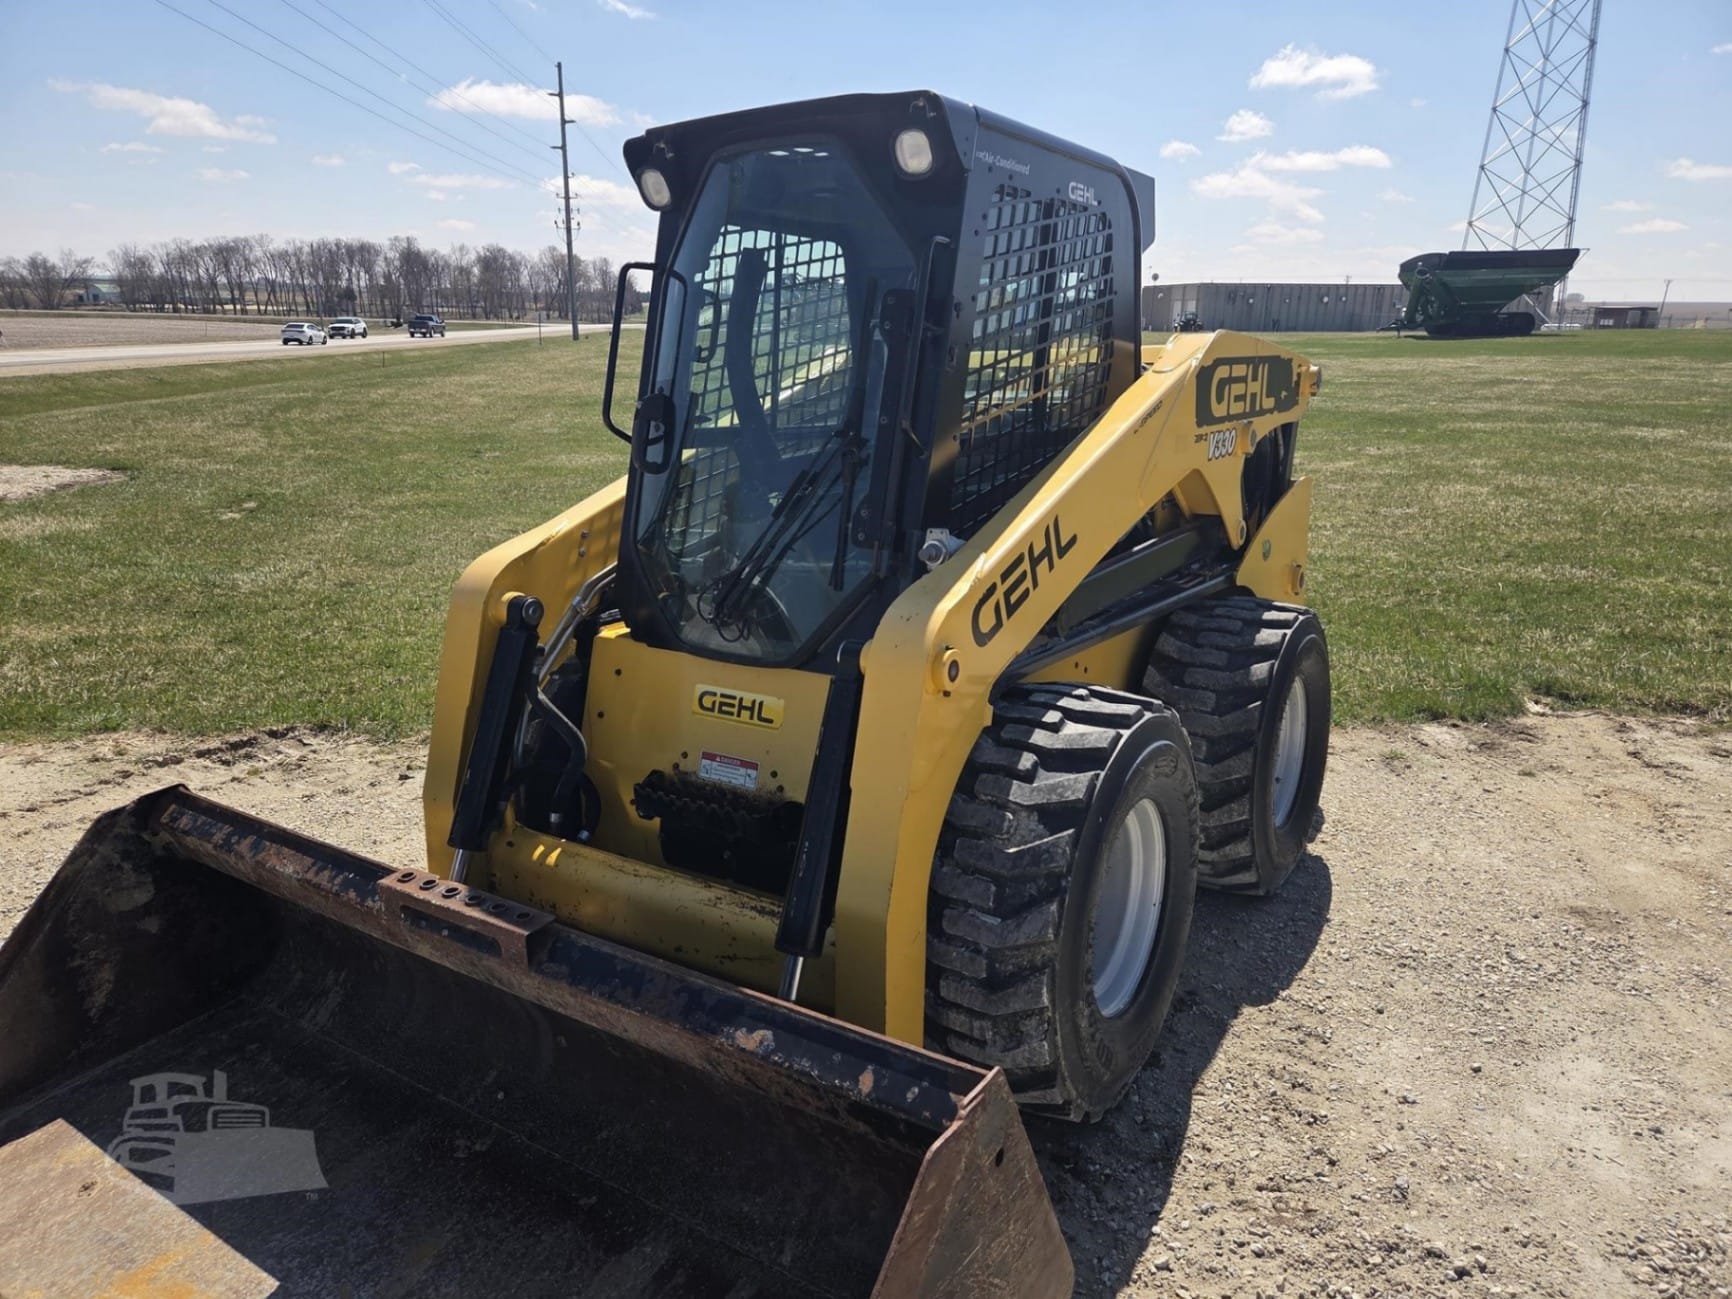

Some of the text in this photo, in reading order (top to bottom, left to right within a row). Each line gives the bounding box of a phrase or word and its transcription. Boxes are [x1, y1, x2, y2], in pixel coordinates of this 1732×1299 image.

[1068, 181, 1099, 207] GEHL
[1210, 363, 1276, 418] GEHL
[1208, 428, 1237, 461] V330
[971, 515, 1078, 648] GEHL
[698, 690, 774, 724] GEHL
